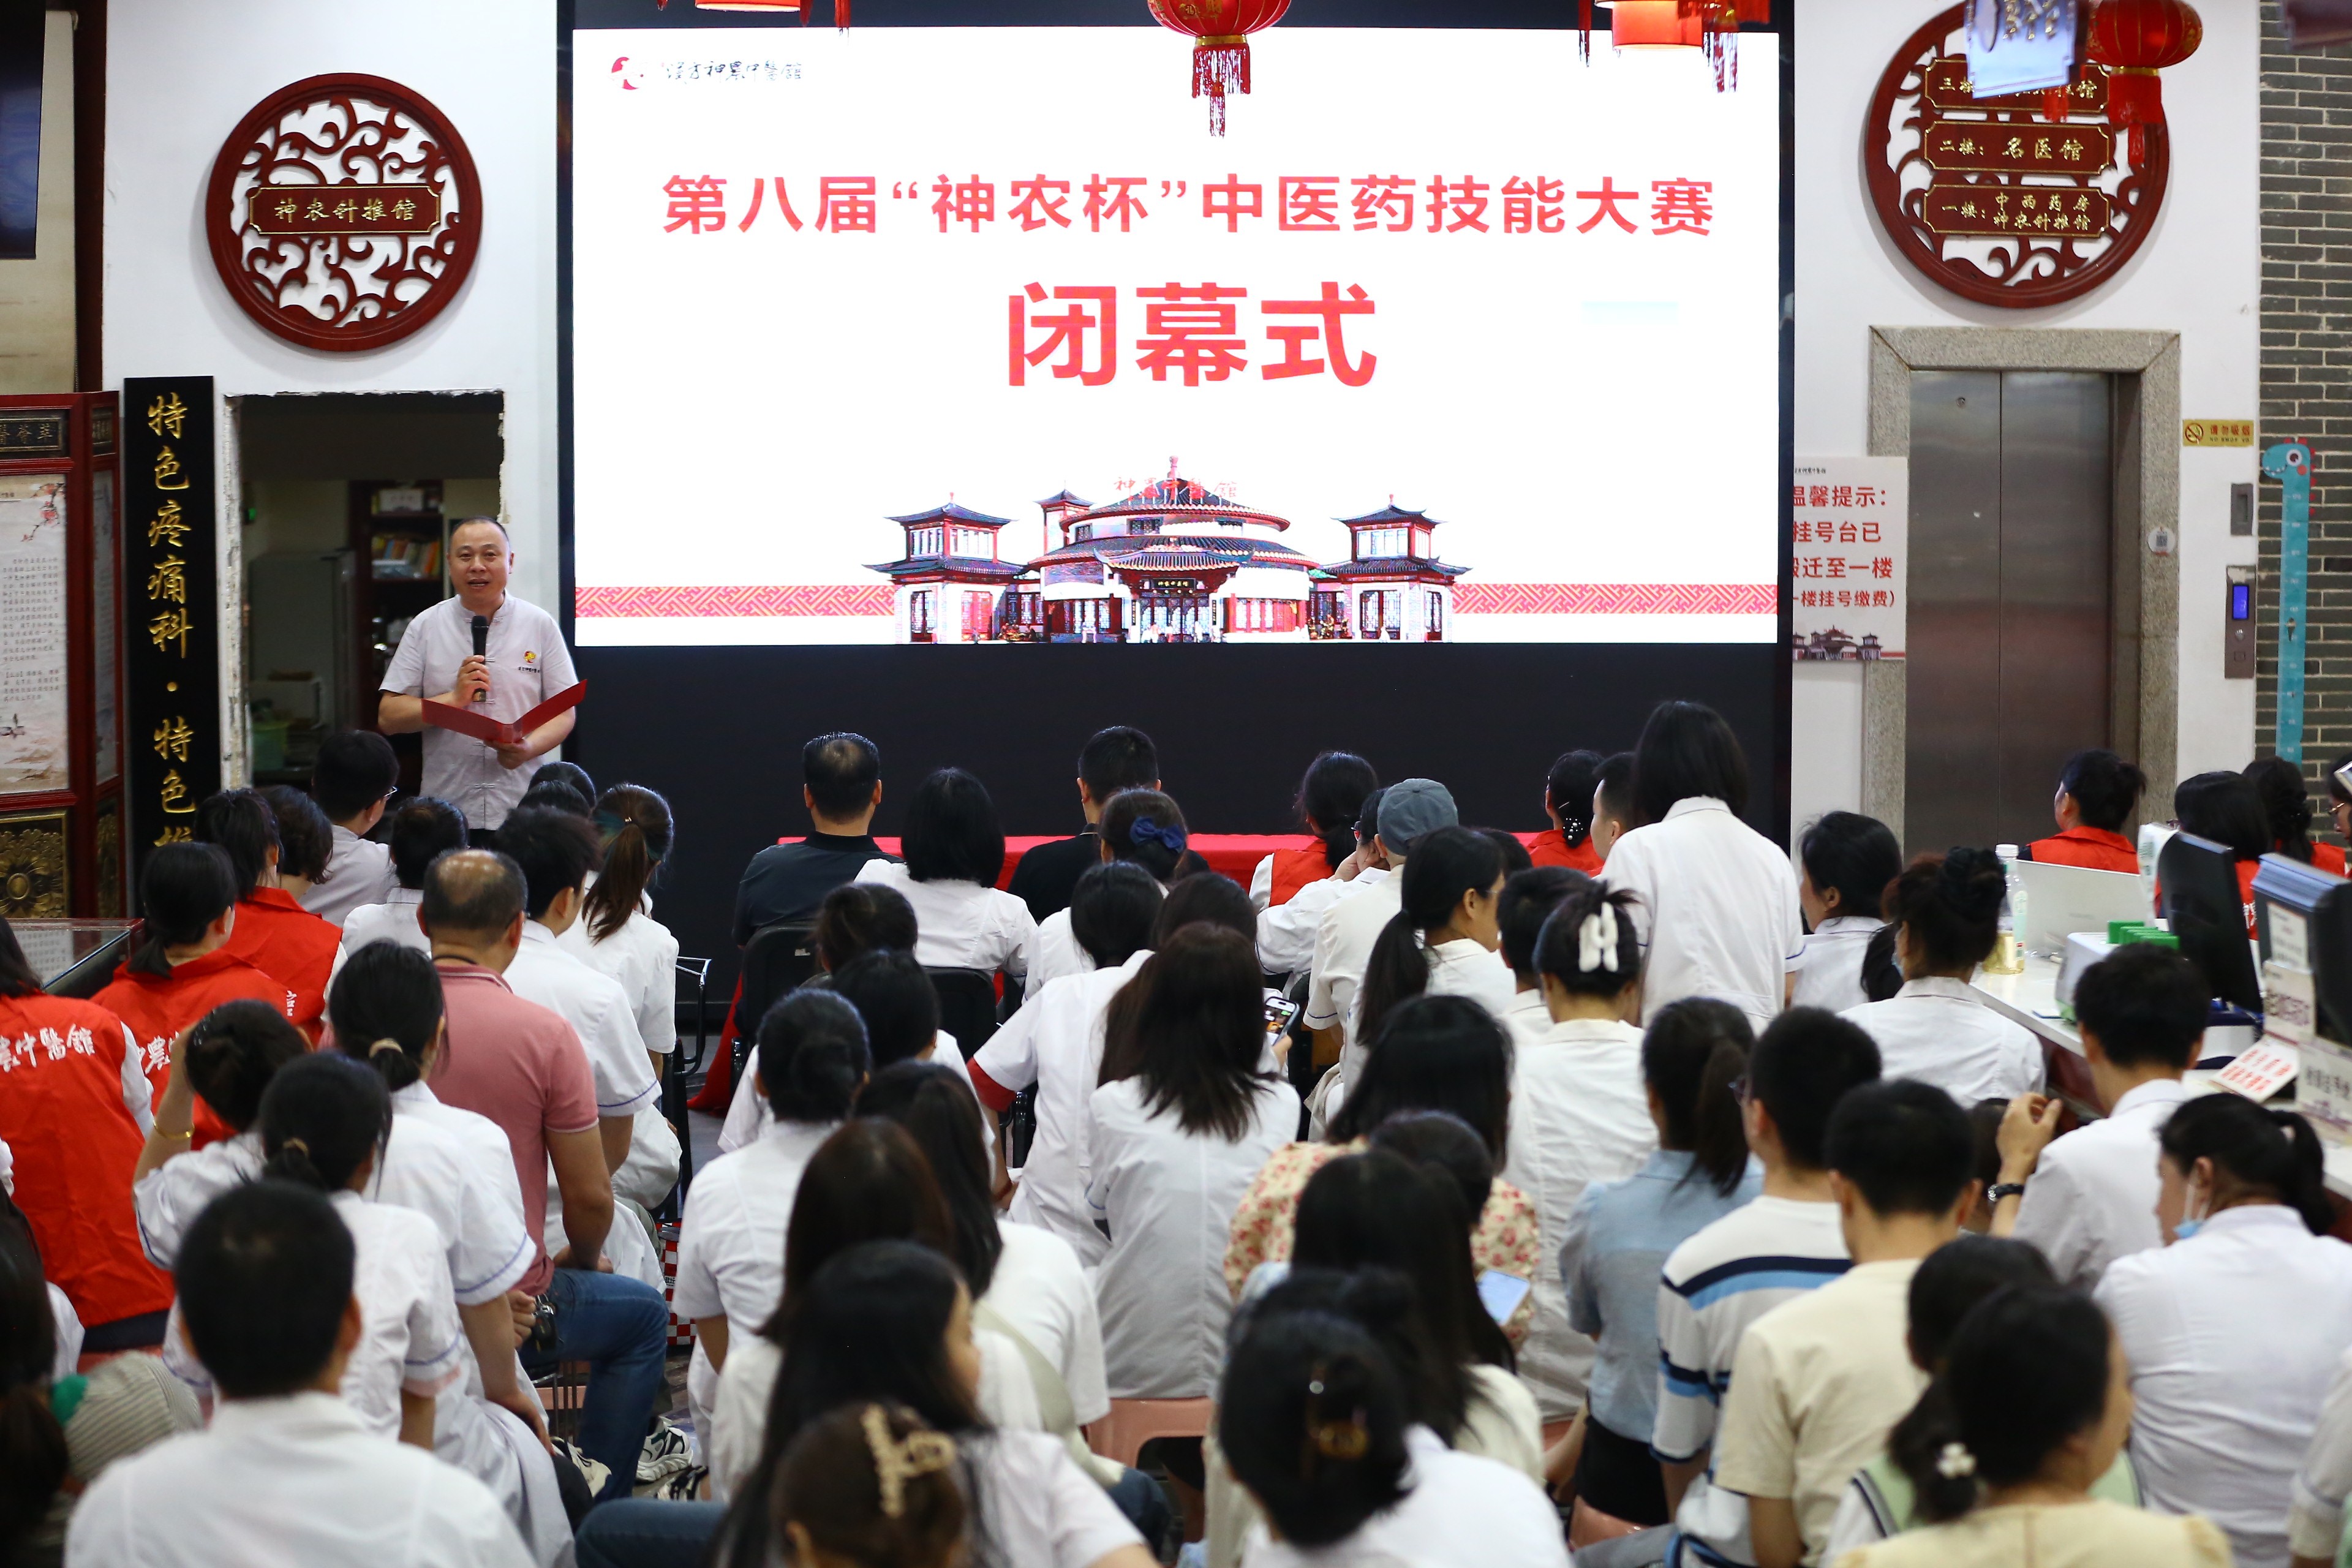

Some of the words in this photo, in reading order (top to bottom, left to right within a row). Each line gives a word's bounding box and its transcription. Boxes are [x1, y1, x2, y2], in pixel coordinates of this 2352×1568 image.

[663, 174, 1714, 236] 第八届“神农杯”中医药技能大赛
[1009, 282, 1378, 388] 闭幕式
[1793, 521, 1882, 544] 挂号台已
